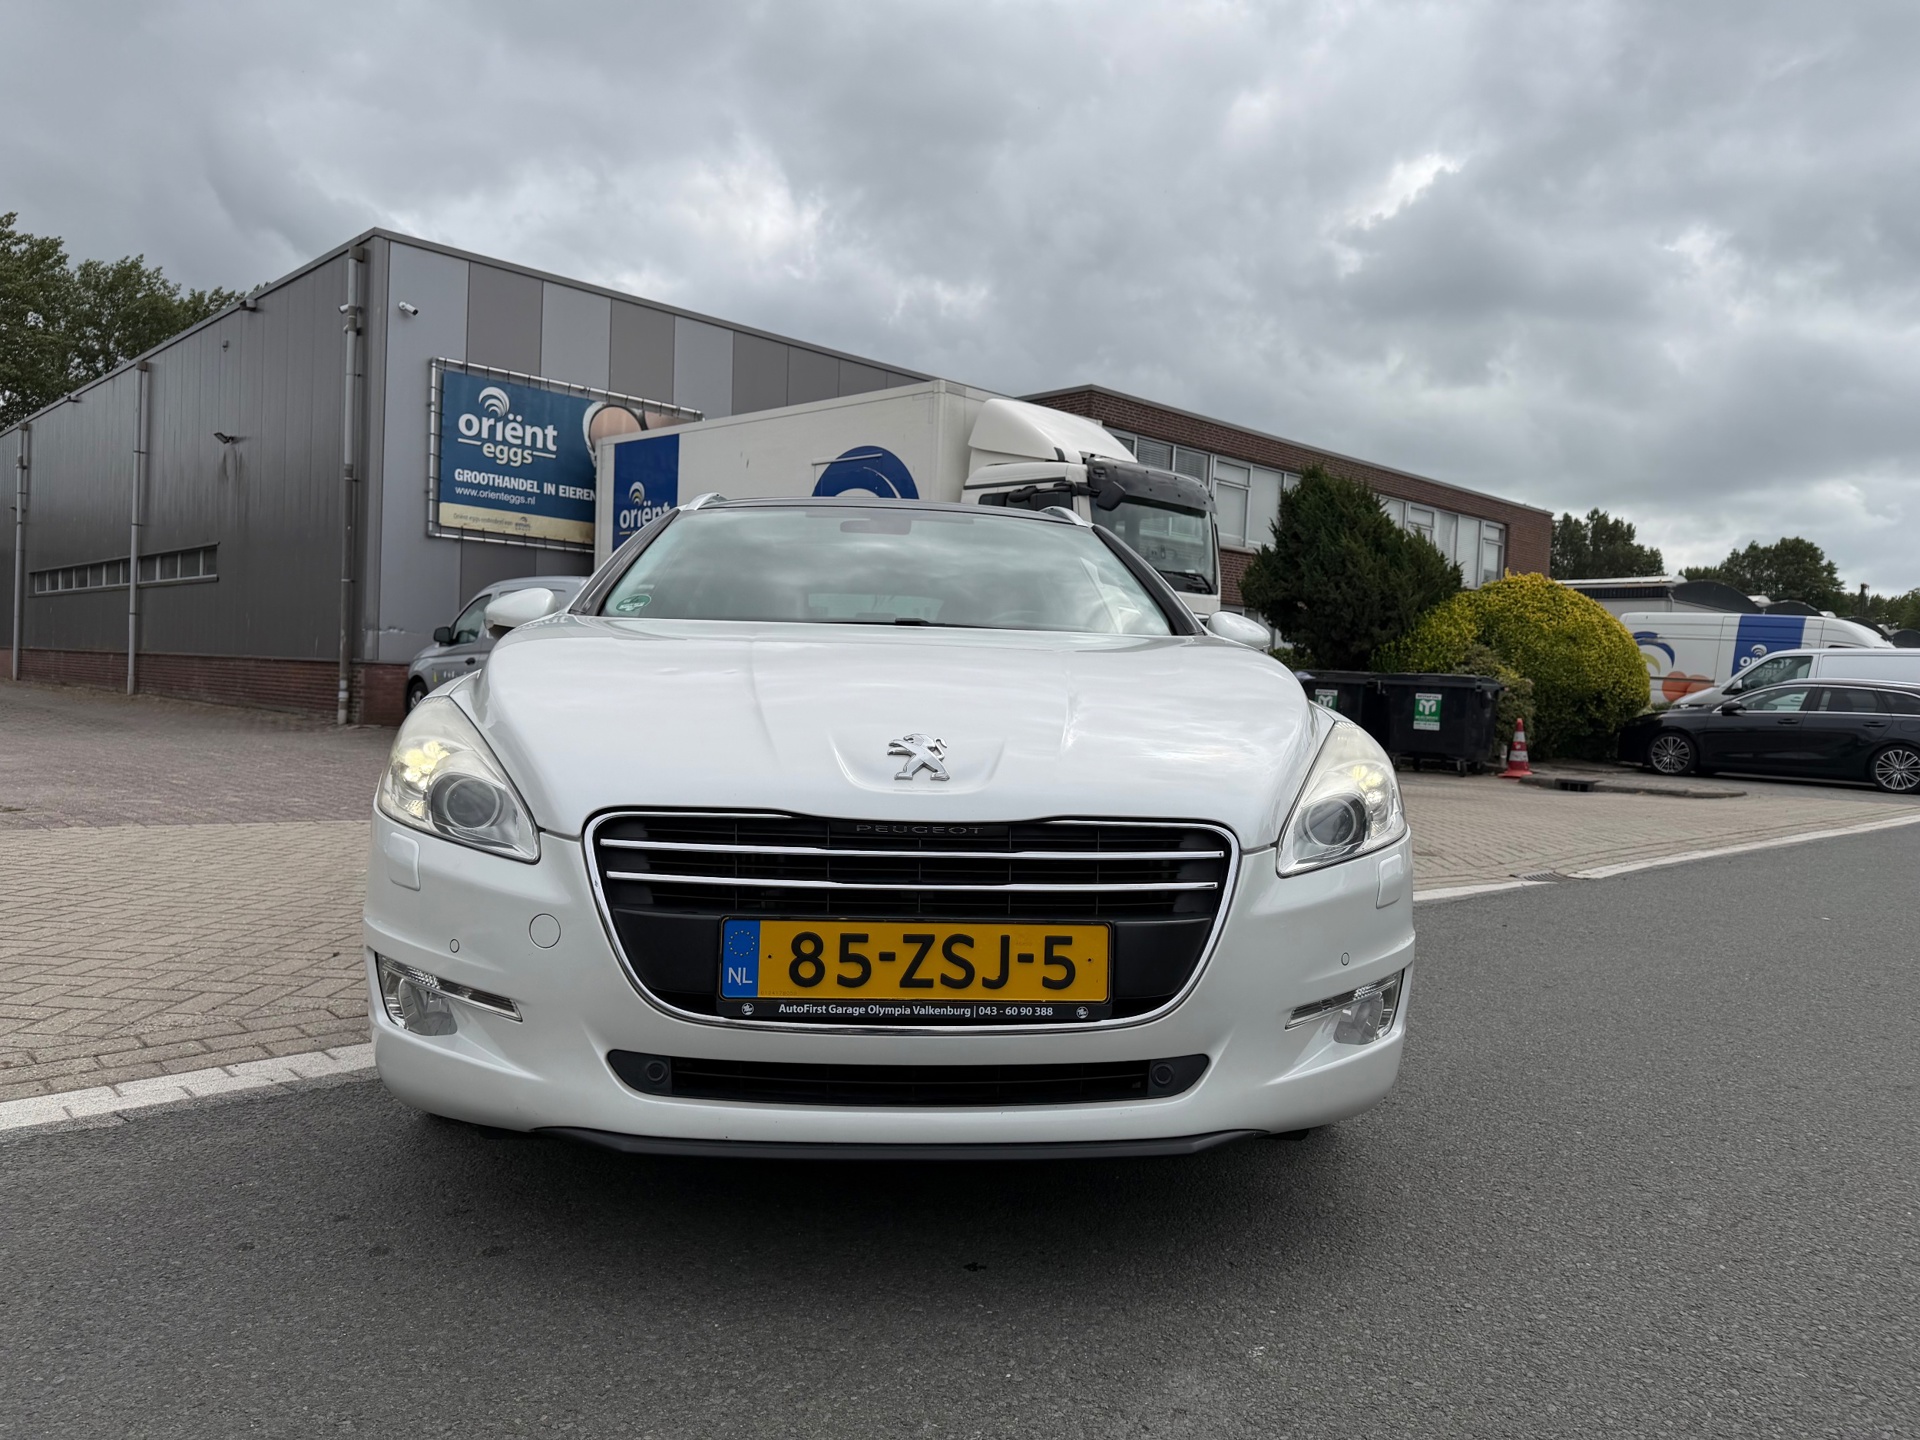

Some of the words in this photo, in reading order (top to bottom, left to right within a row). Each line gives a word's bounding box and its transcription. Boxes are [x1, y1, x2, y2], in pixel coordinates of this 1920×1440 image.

[458, 413, 558, 452] oriënt
[482, 442, 533, 467] eggs
[454, 468, 540, 494] GROOTHANDEL
[543, 482, 556, 496] IN
[455, 486, 536, 505] www.orienteggs.nl
[856, 824, 984, 835] PEUGEOT
[788, 931, 1077, 990] 85-ZSJ-5
[728, 967, 753, 985] NL
[779, 1004, 826, 1014] AutoFirst
[828, 1004, 865, 1016] Garage
[867, 1005, 910, 1016] Olympia
[912, 1005, 971, 1017] Valkenburg
[978, 1006, 997, 1015] 043
[1005, 1007, 1018, 1015] 60
[1020, 1007, 1032, 1015] 90
[1034, 1007, 1053, 1016] 388
